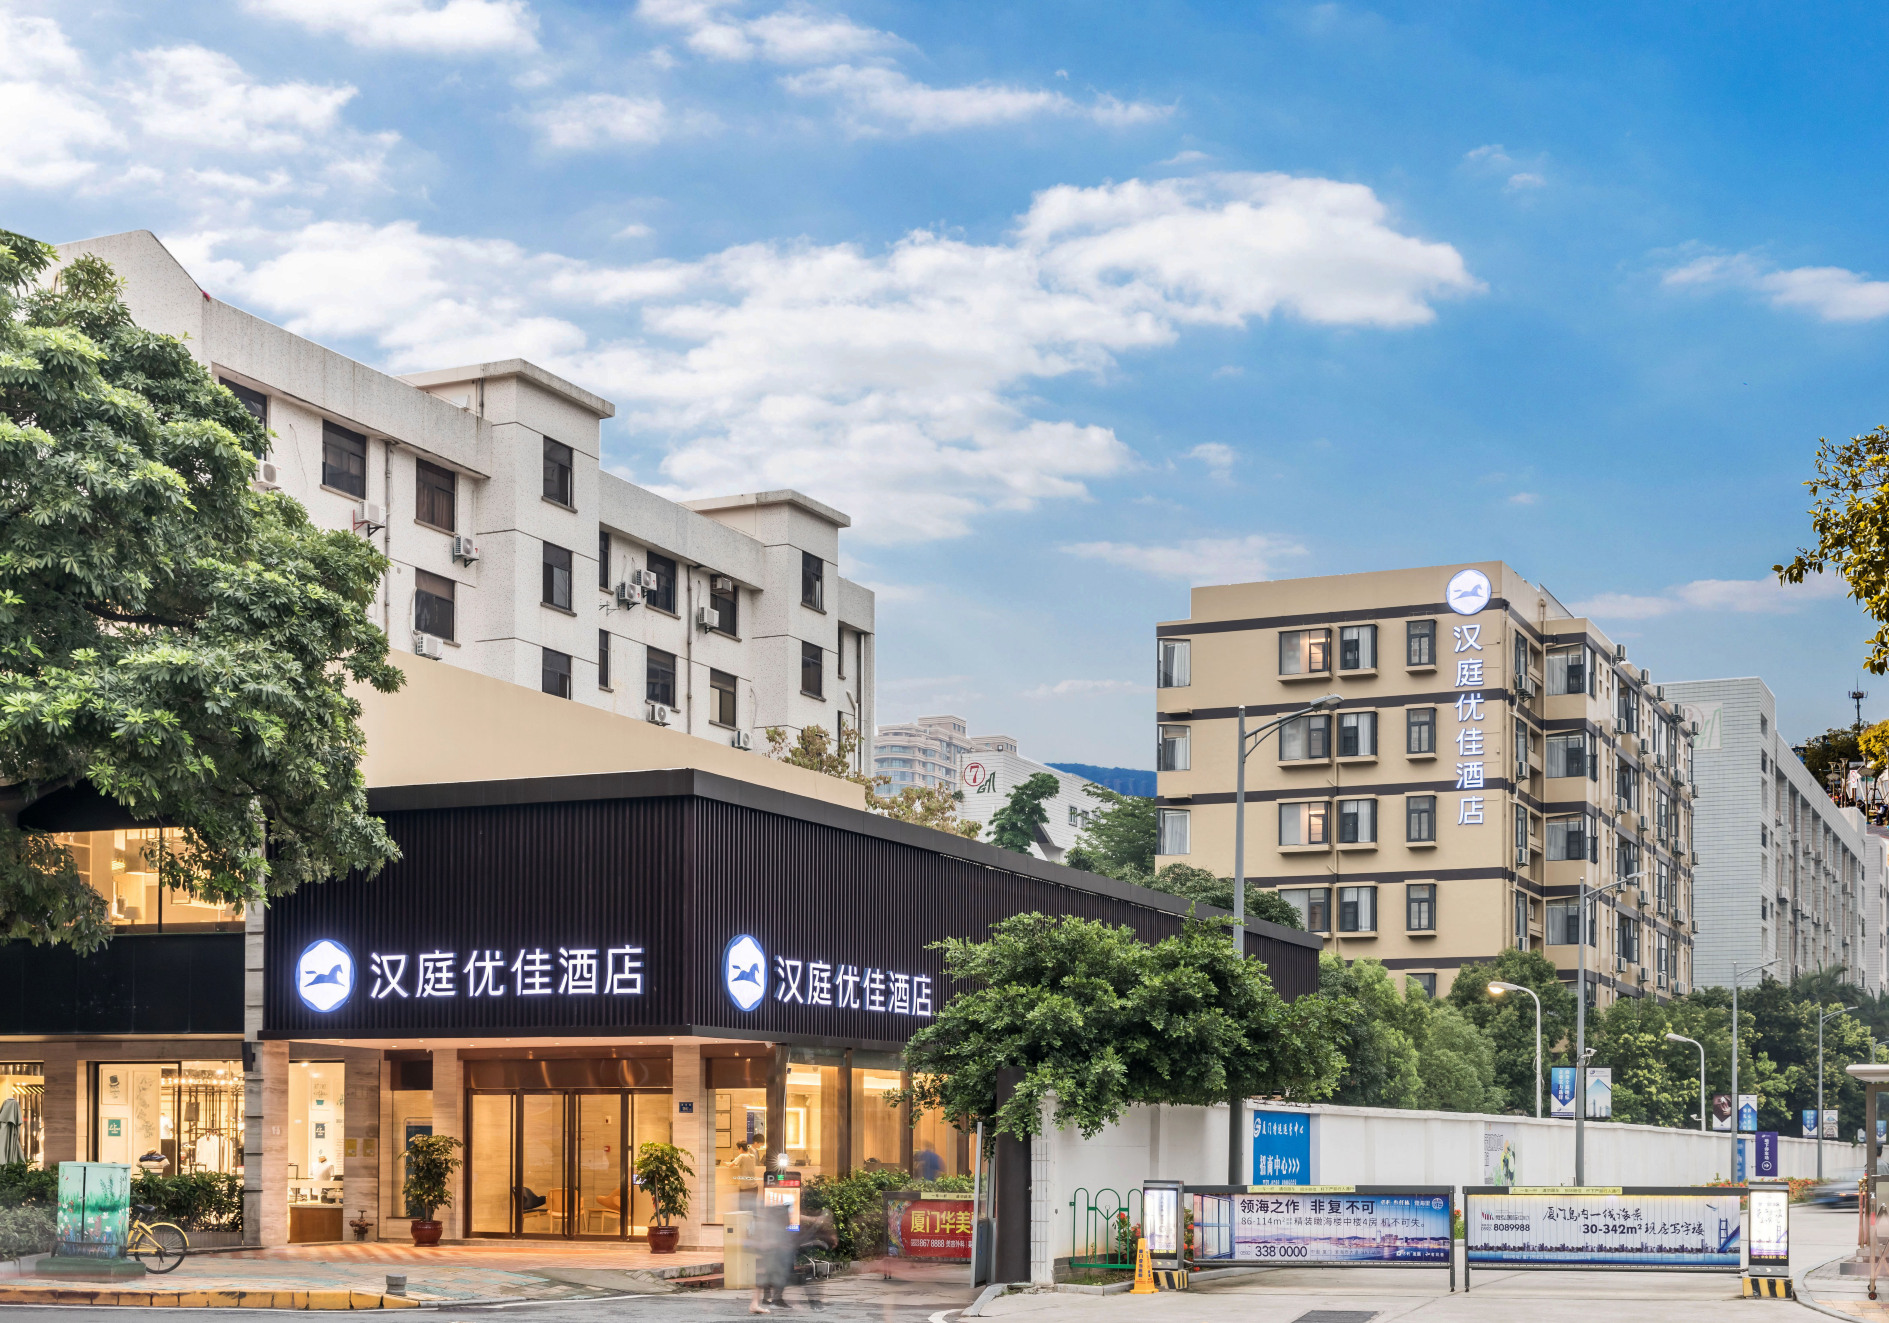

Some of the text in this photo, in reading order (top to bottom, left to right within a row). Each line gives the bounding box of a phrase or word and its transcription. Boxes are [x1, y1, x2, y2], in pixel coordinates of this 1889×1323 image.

[1452, 623, 1485, 825] 汉庭优佳酒店
[969, 764, 980, 784] 7
[369, 944, 644, 1000] 汉庭优佳酒店
[773, 955, 932, 1017] 汉庭优佳酒店
[767, 1175, 775, 1185] P
[1240, 1199, 1300, 1214] 领海之作
[1310, 1199, 1376, 1215] 非复不可
[1542, 1206, 1643, 1222] 厦门岛内一线海景
[911, 1210, 974, 1234] 厦门华美
[1493, 1223, 1531, 1232] 8089988
[1582, 1222, 1705, 1236] 30-342m² 现房写字楼
[1255, 1246, 1276, 1257] 338
[1279, 1246, 1308, 1257] 0000
